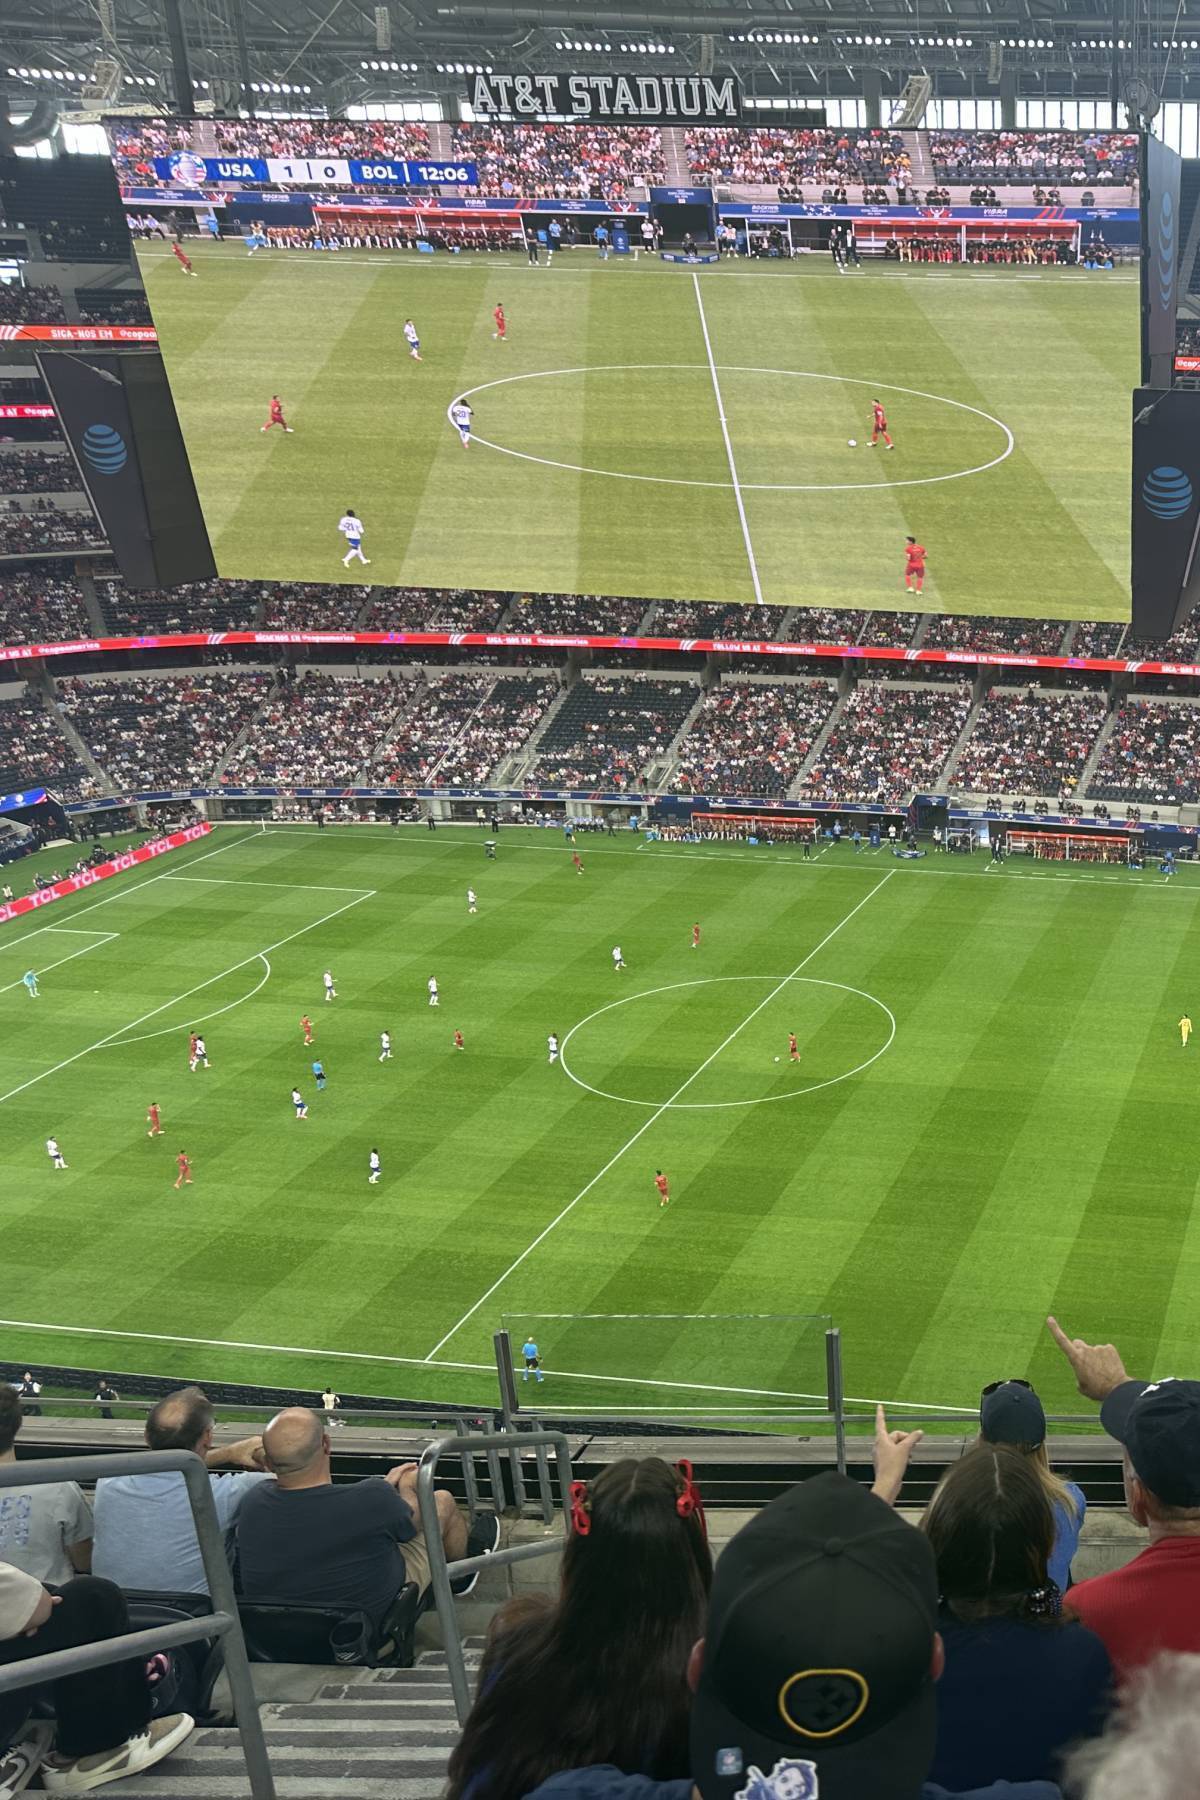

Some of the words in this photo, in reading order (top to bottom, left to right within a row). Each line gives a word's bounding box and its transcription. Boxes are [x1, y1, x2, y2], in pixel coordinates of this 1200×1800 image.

[471, 75, 558, 113] AT&T
[569, 76, 738, 116] STADIUM
[218, 162, 253, 178] USA
[284, 165, 294, 178] 1
[324, 166, 336, 178] 0
[362, 165, 398, 180] BOL
[418, 166, 469, 181] 12:06
[183, 822, 207, 841] TCL
[148, 838, 175, 857] TCL
[111, 853, 138, 872] TCL
[71, 869, 101, 889] TCL
[28, 888, 61, 907] TCL
